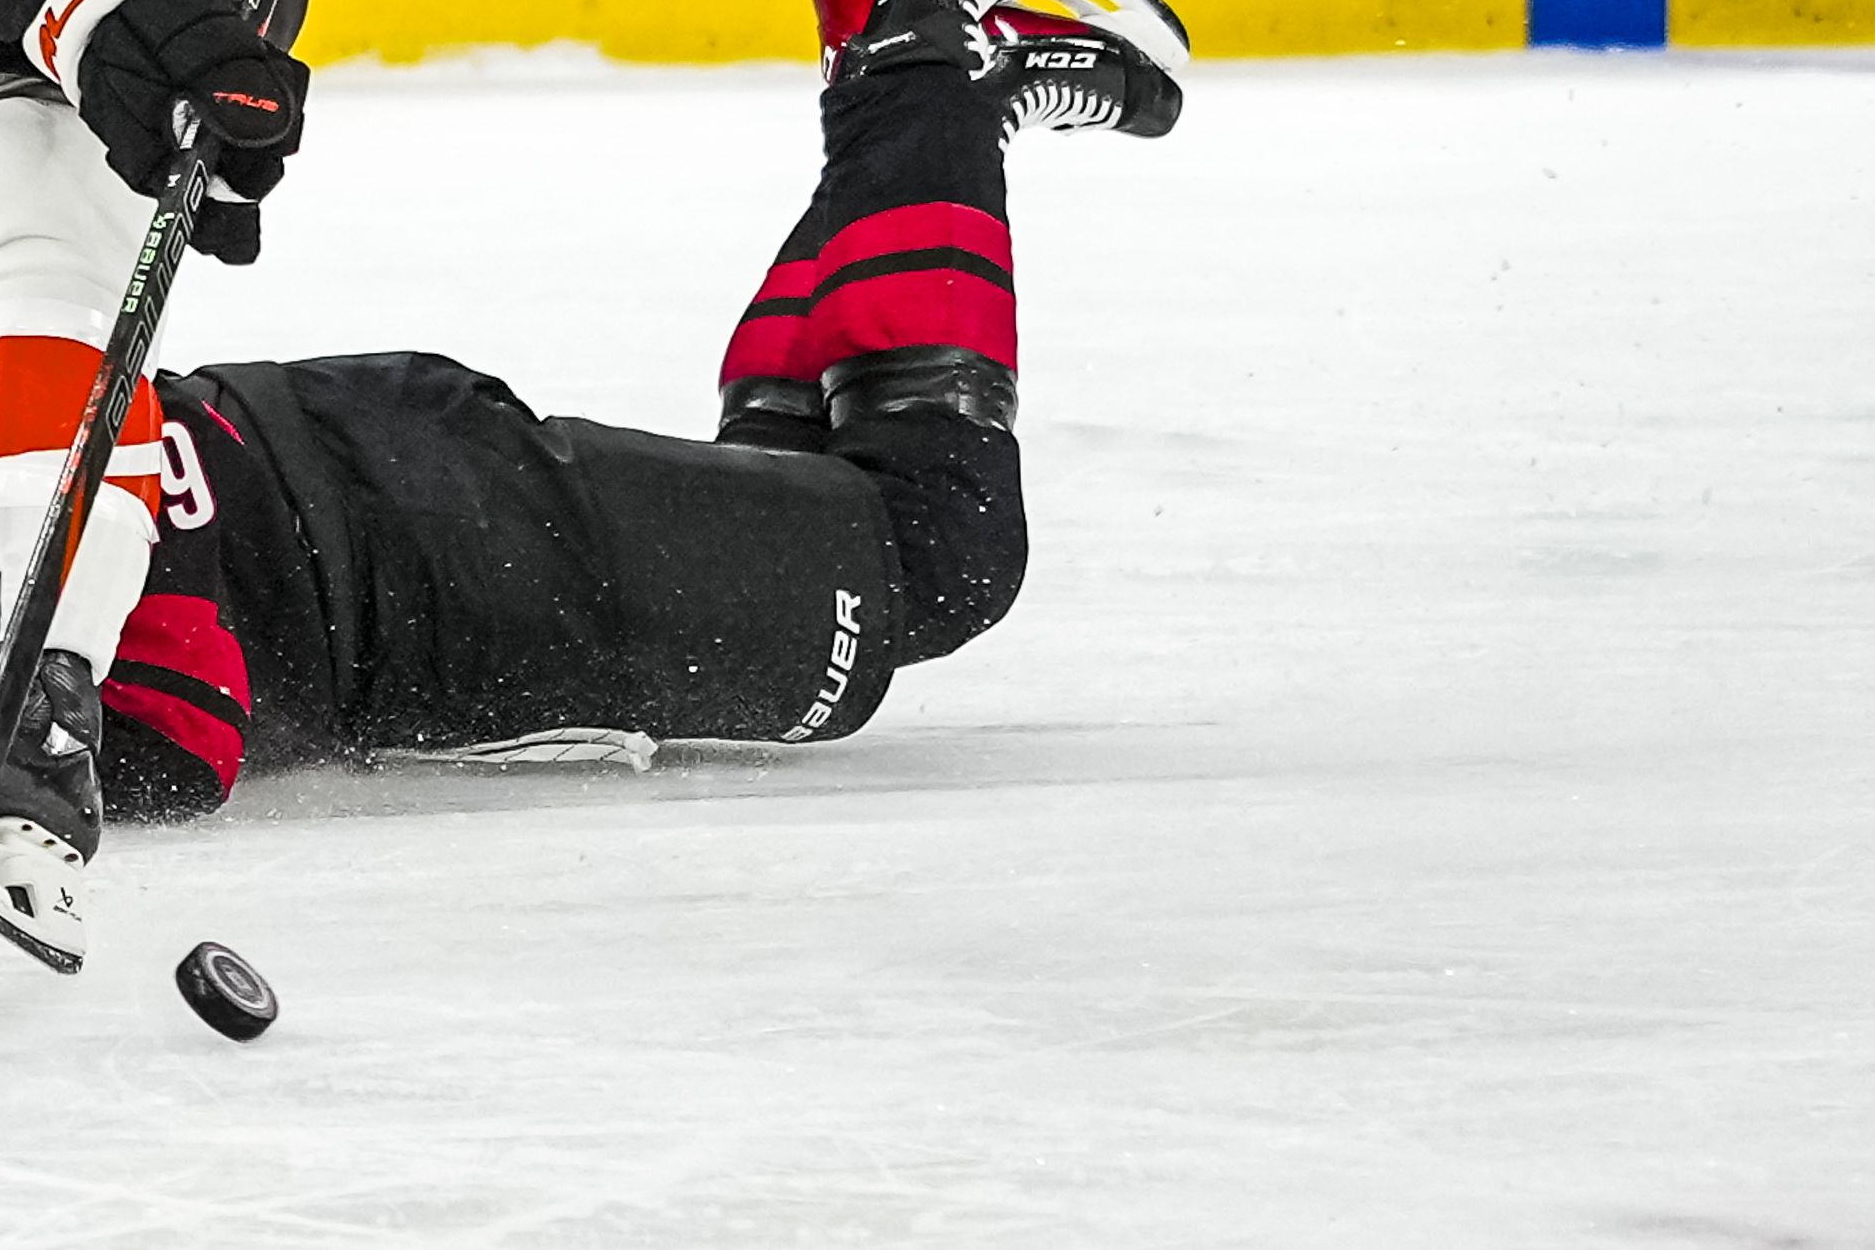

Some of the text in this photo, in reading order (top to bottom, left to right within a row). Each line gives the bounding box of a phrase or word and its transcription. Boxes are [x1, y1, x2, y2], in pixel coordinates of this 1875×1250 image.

[1025, 51, 1098, 69] CCM
[213, 91, 280, 113] TRUE
[780, 588, 862, 741] BAUER
